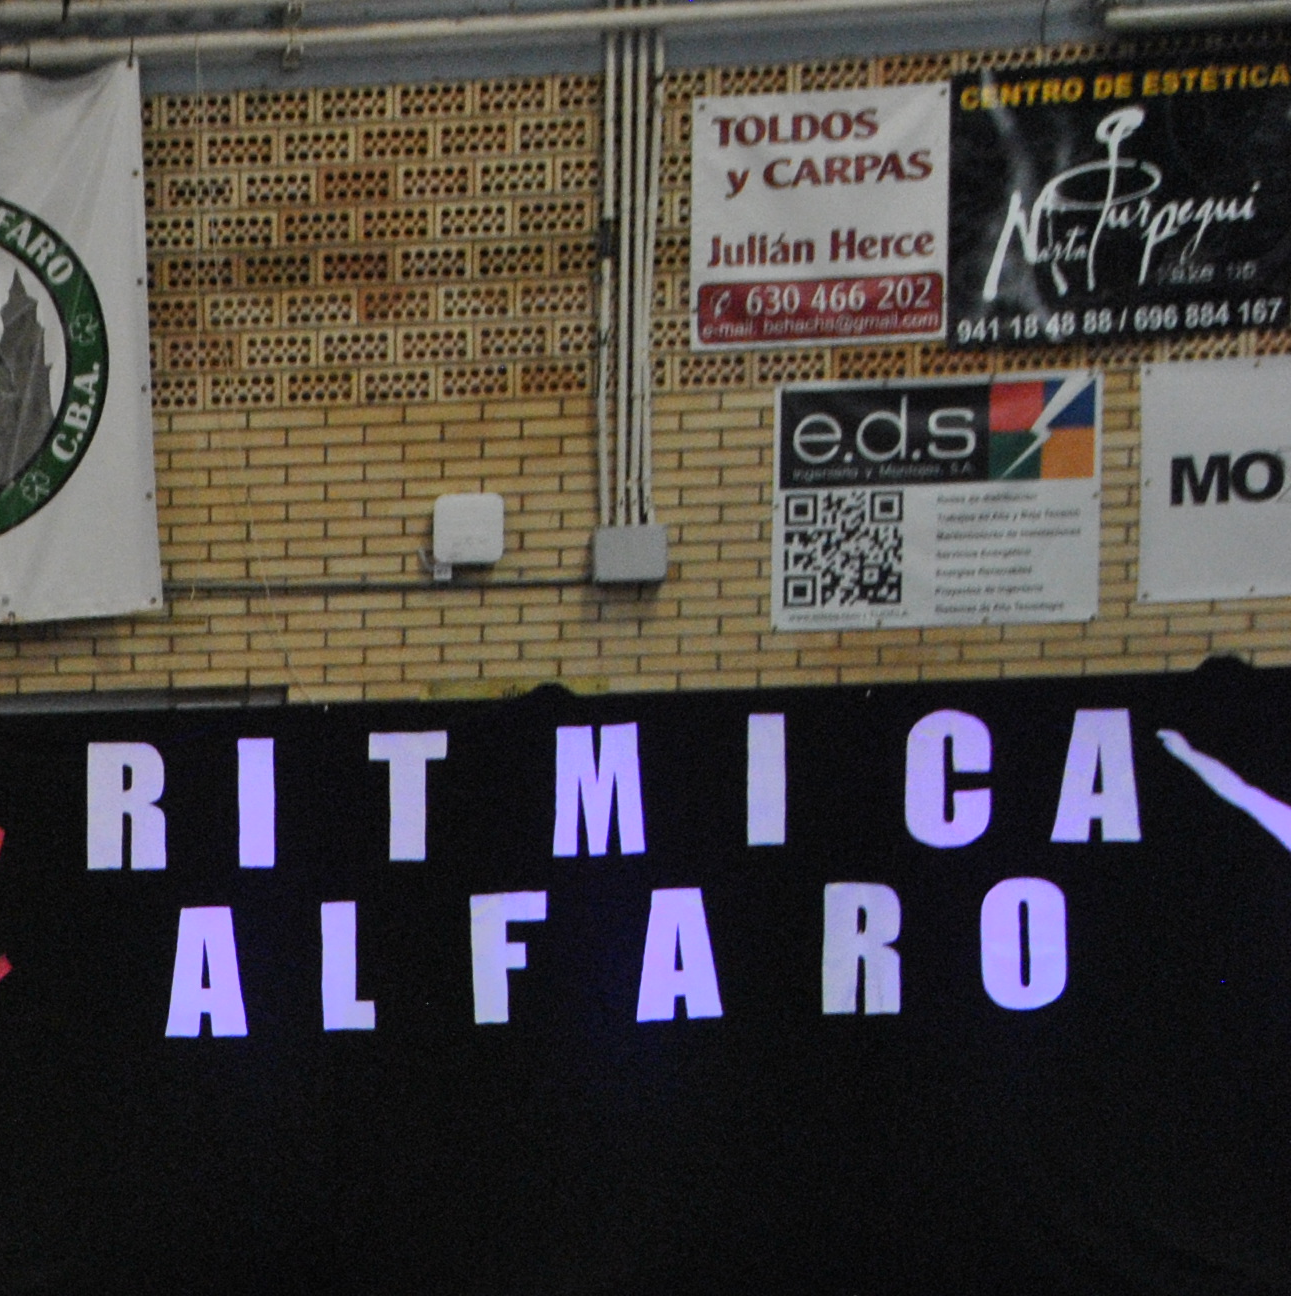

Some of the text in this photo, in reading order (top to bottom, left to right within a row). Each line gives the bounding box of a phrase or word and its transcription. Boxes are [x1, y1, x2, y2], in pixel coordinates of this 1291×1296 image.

[960, 76, 1085, 110] CENTRO
[1093, 72, 1134, 100] DE
[711, 107, 880, 147] TOLDOS
[725, 149, 933, 200] y CARPAS
[707, 228, 935, 268] Julián Herce
[746, 278, 932, 316] 630 466 202
[957, 317, 999, 344] 941
[1010, 313, 1038, 339] 18
[1045, 310, 1075, 338] 48
[1083, 308, 1112, 334] 88
[1238, 298, 1282, 324] 167
[1170, 451, 1286, 506] MO
[86, 708, 1142, 871] RITMICA
[164, 876, 1068, 1038] ALFARO
